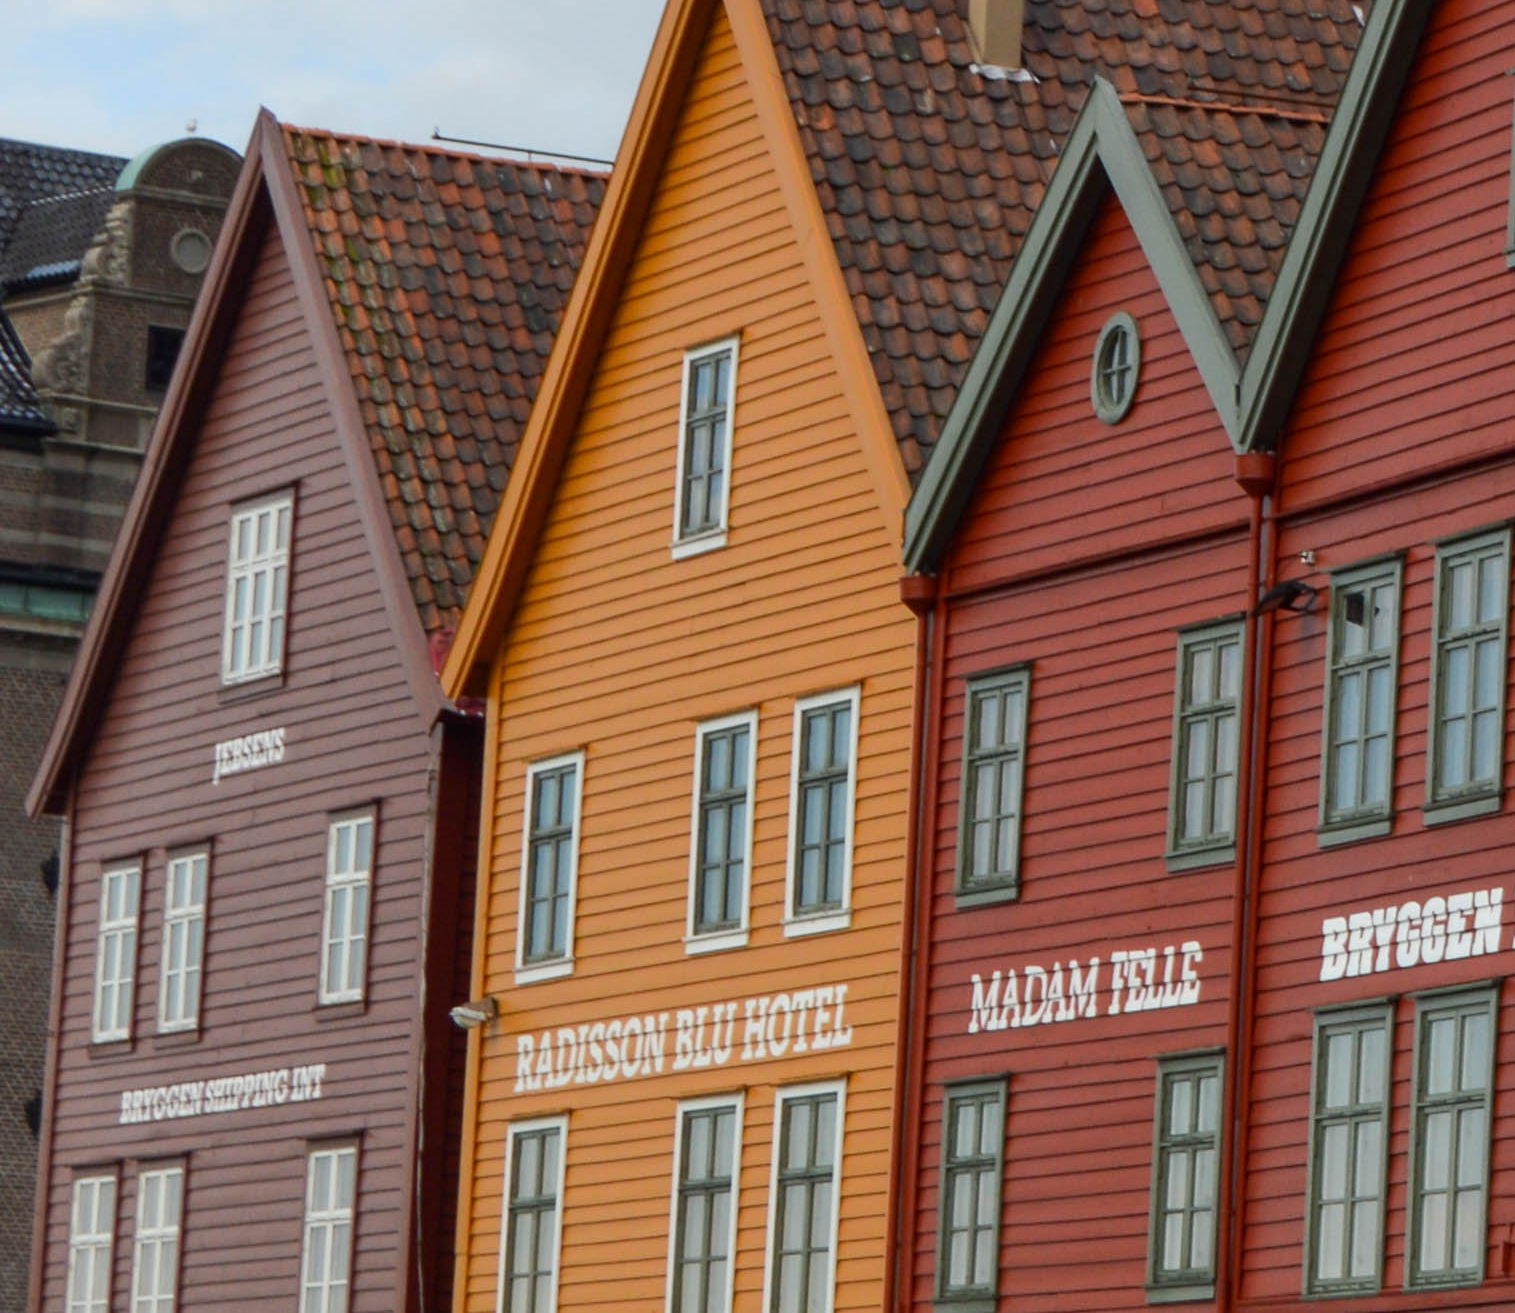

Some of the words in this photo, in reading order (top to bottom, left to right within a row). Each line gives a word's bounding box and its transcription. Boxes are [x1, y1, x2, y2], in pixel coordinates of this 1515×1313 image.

[212, 727, 285, 785] JEBSENS
[1319, 887, 1504, 982] BRYGGEN
[967, 956, 1101, 1034] MADAM
[1108, 940, 1203, 1015] FELLE
[513, 1011, 671, 1093] RADISSON
[671, 1001, 738, 1070] BLU
[740, 984, 853, 1061] HOTEL
[119, 1080, 204, 1125] BRYGGEN
[290, 1063, 327, 1102] INT
